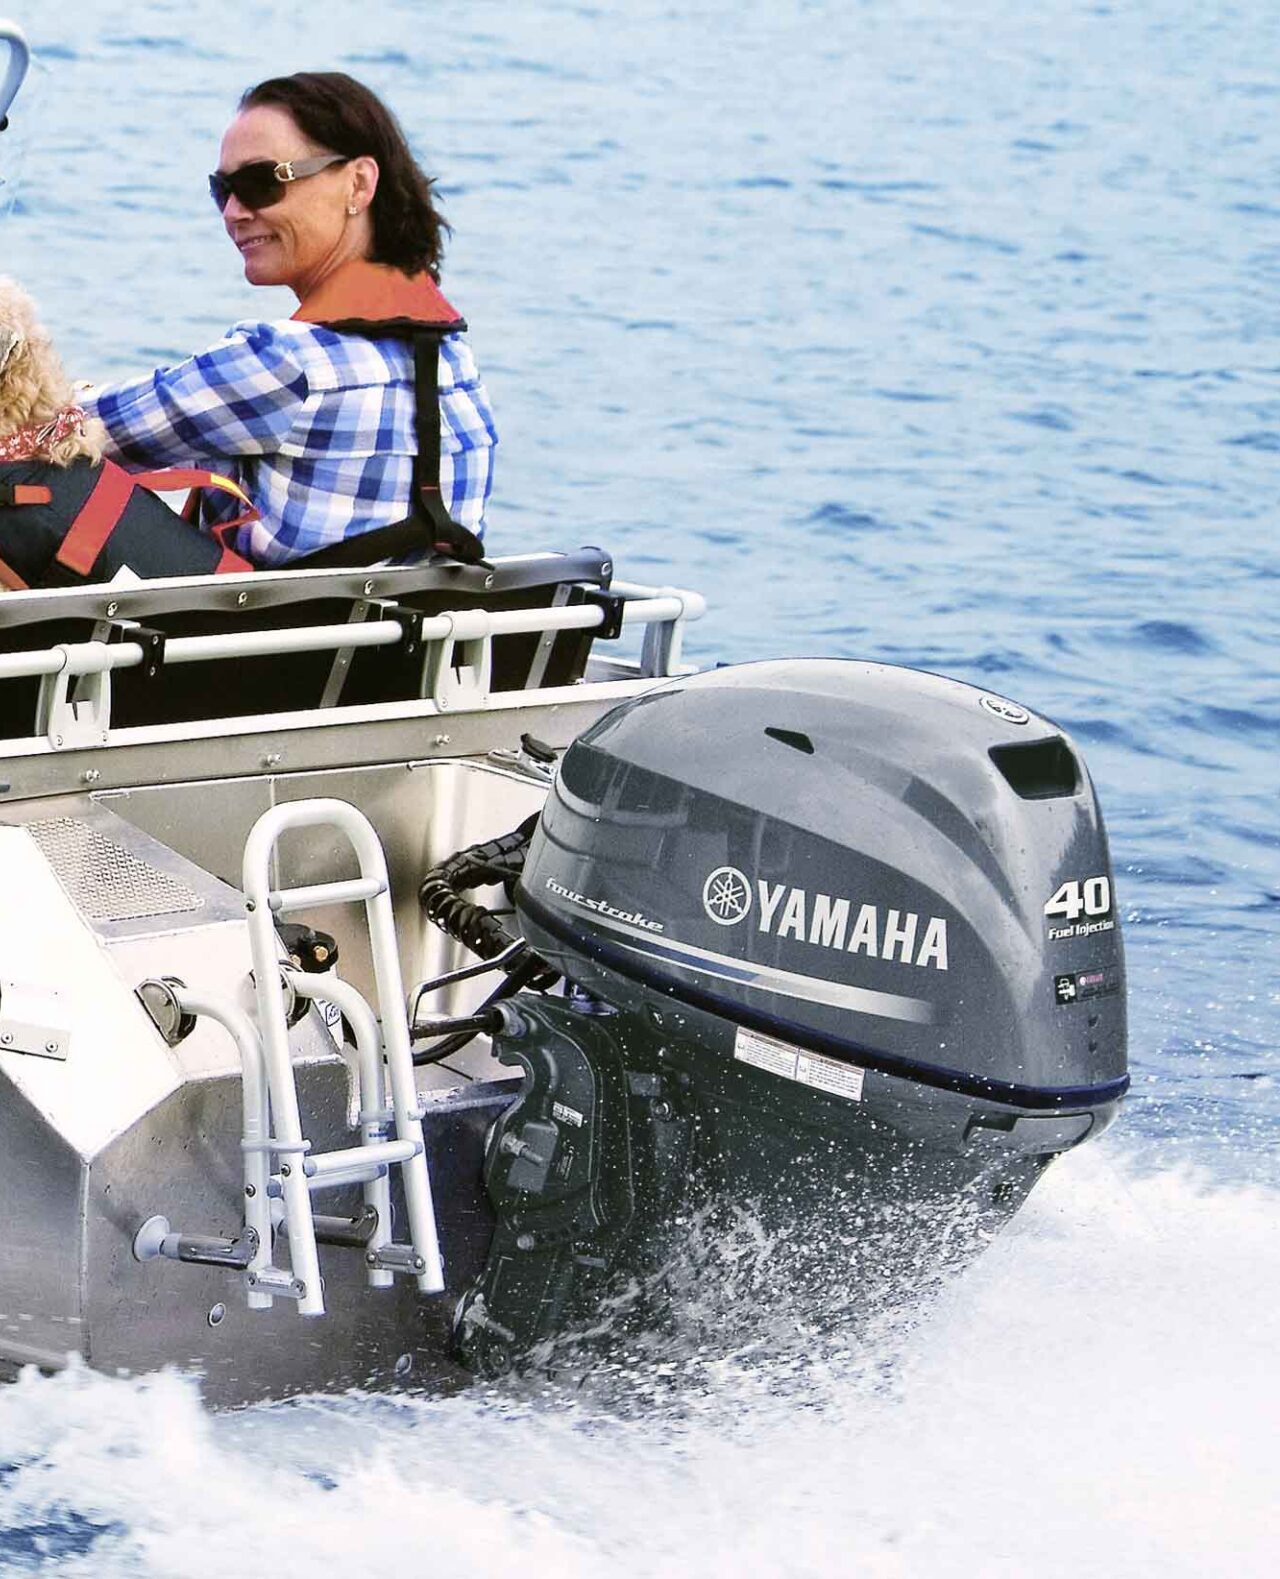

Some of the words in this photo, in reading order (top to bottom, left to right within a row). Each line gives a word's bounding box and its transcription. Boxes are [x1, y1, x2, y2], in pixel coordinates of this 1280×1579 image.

[546, 877, 664, 933] fourstroke
[1044, 876, 1110, 919] 40
[758, 879, 948, 970] YAMAHA
[1048, 925, 1074, 940] Fuel
[1075, 920, 1114, 937] Injection
